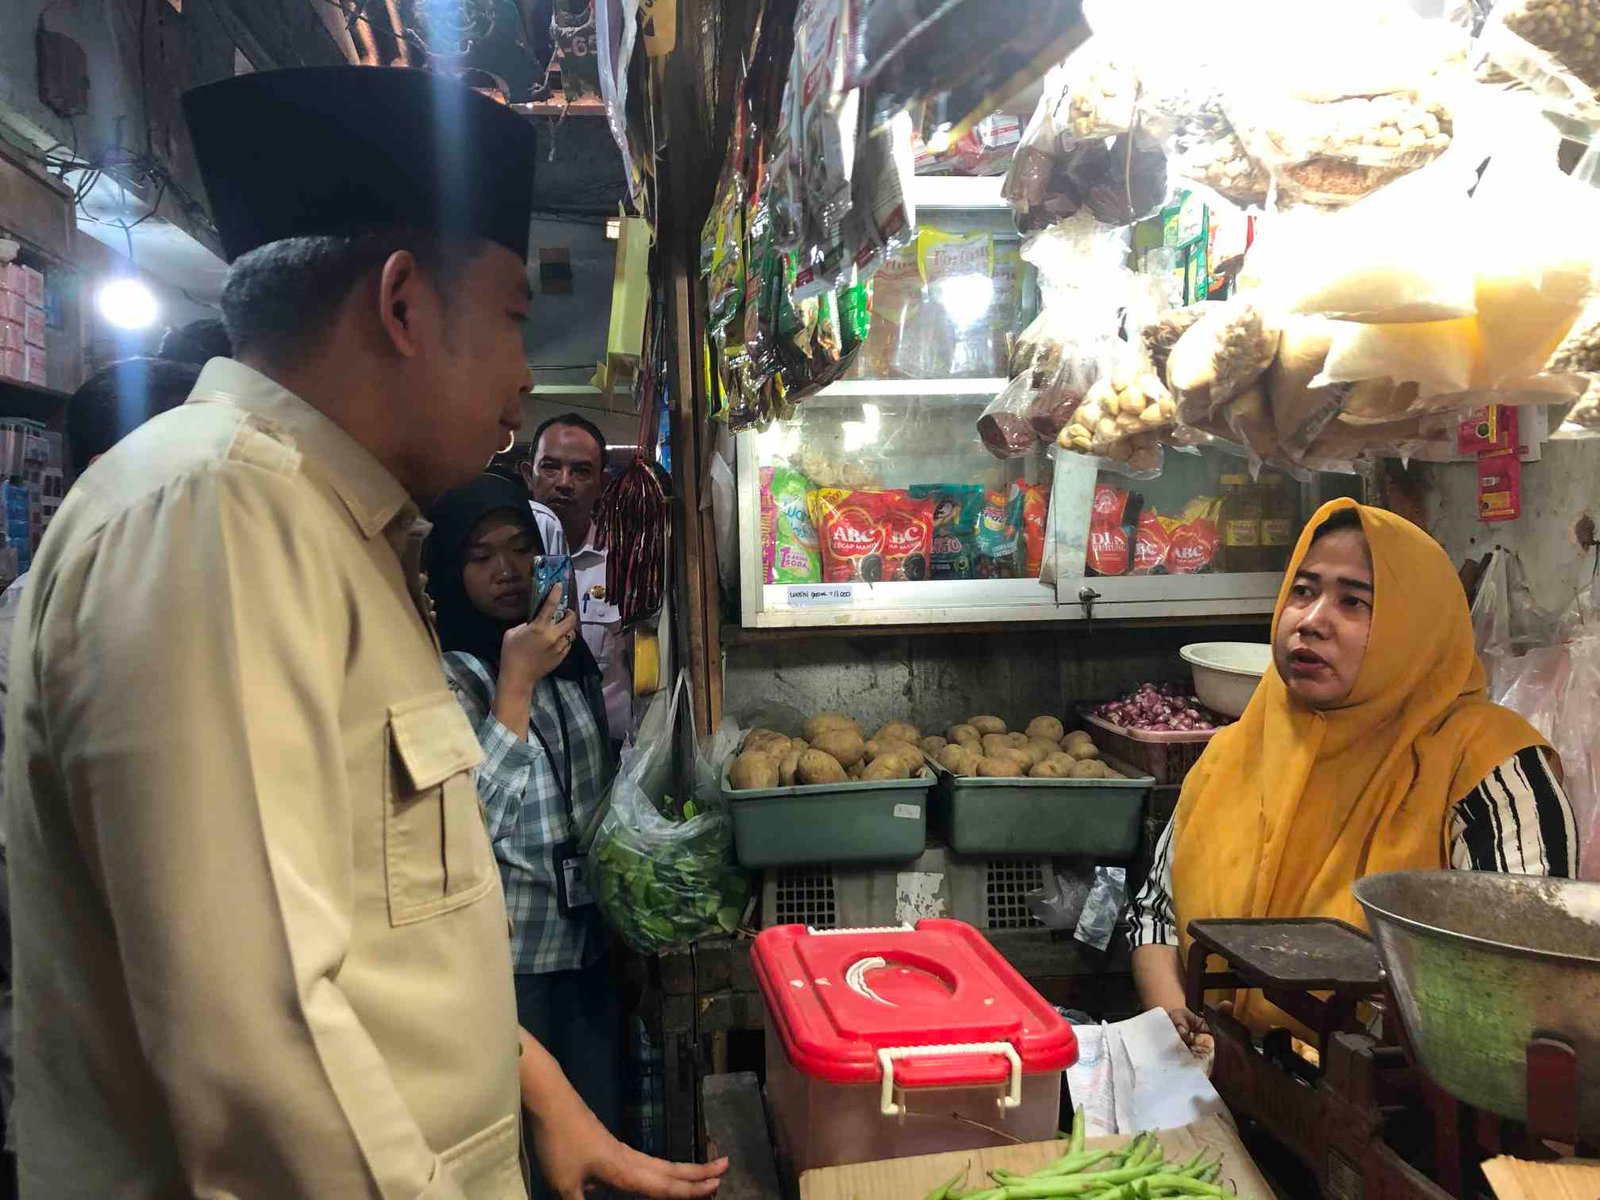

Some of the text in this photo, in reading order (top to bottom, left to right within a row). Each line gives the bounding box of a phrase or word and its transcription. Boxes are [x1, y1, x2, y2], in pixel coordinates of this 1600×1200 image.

[833, 525, 879, 543] ABC
[889, 525, 921, 543] BC
[1174, 545, 1204, 558] ABC
[786, 559, 807, 568] SODA
